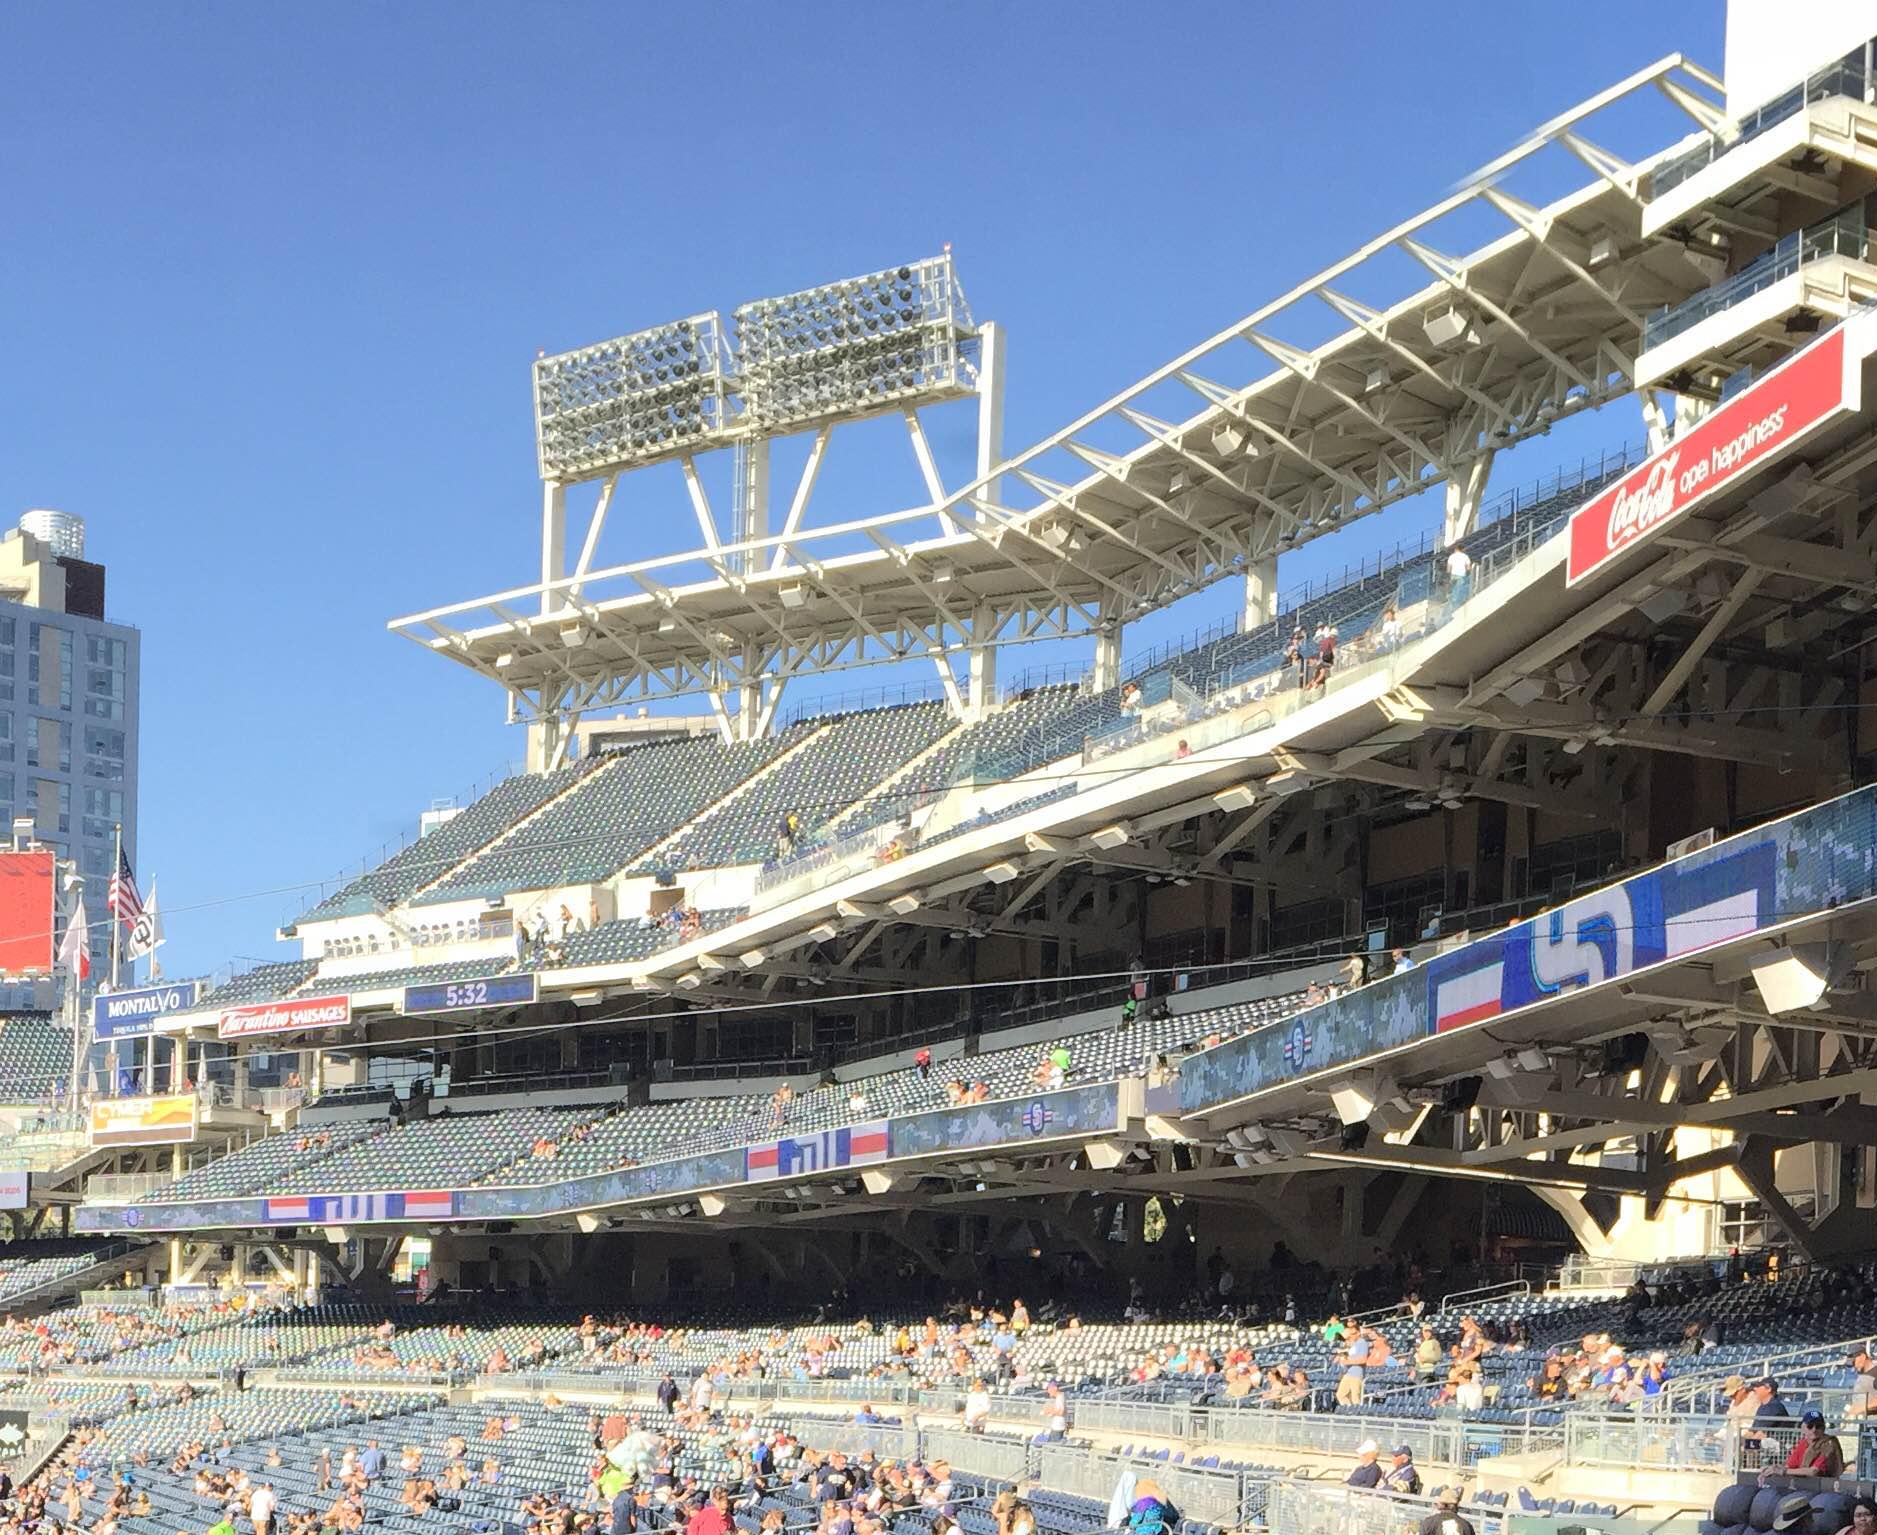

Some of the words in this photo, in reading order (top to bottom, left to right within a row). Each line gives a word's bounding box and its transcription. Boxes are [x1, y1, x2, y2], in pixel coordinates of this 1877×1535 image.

[107, 986, 181, 1019] MONTALVO
[445, 982, 488, 1007] 5:32
[219, 1007, 288, 1036] Tarantino
[289, 1004, 348, 1026] SAUSAGES
